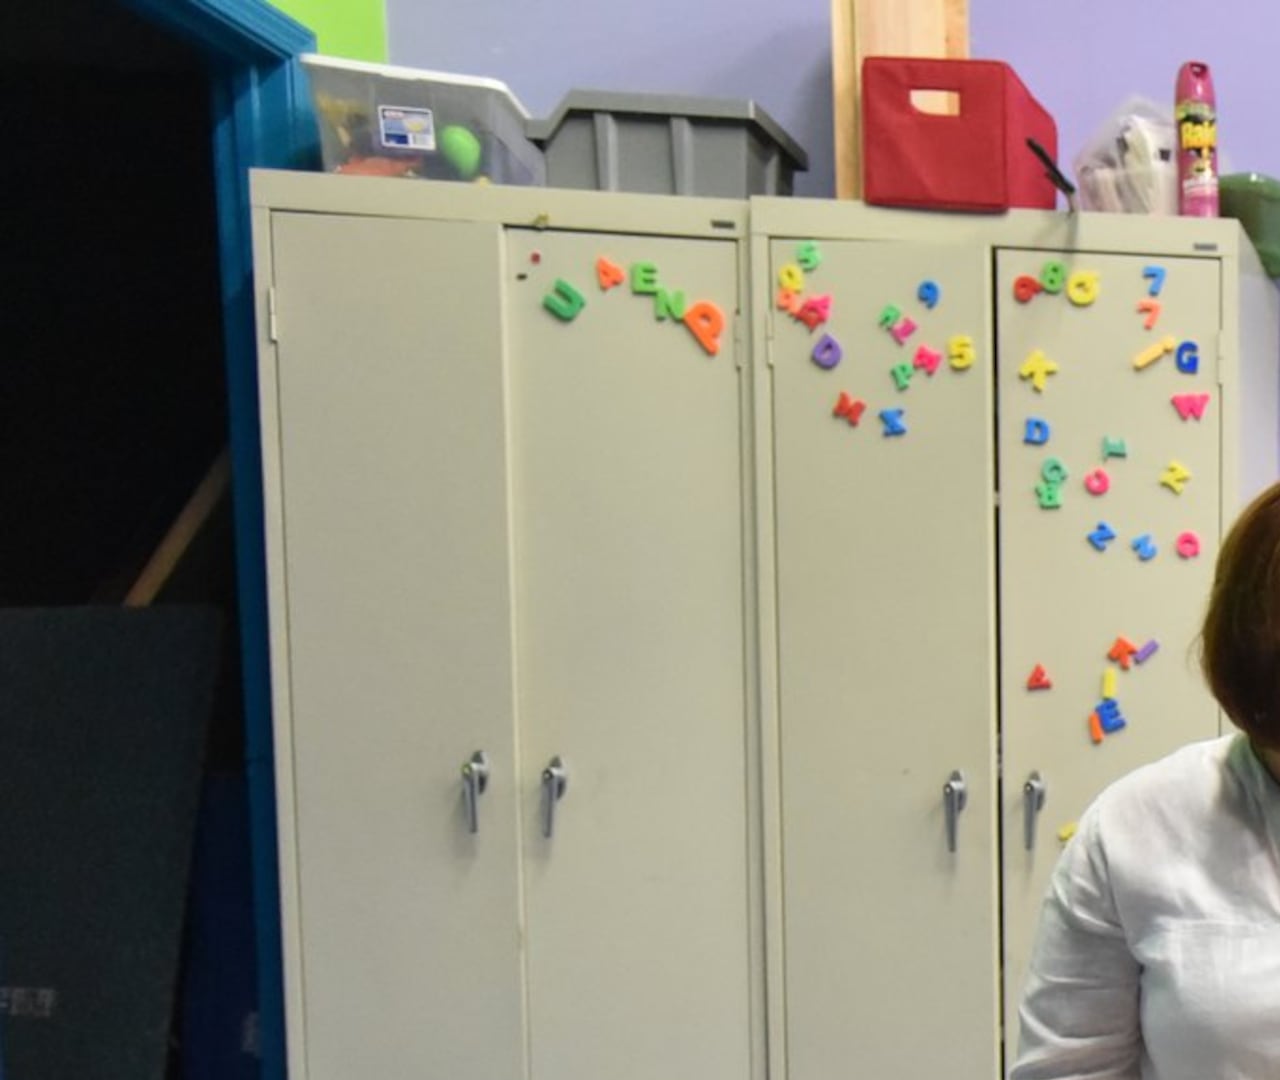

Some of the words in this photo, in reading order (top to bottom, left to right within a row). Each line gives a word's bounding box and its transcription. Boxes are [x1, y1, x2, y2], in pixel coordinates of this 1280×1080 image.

[631, 262, 659, 295] E
[1142, 264, 1167, 297] 7
[1136, 299, 1161, 331] 7
[1175, 340, 1199, 375] G
[1023, 416, 1050, 446] D
[1095, 698, 1128, 734] E
